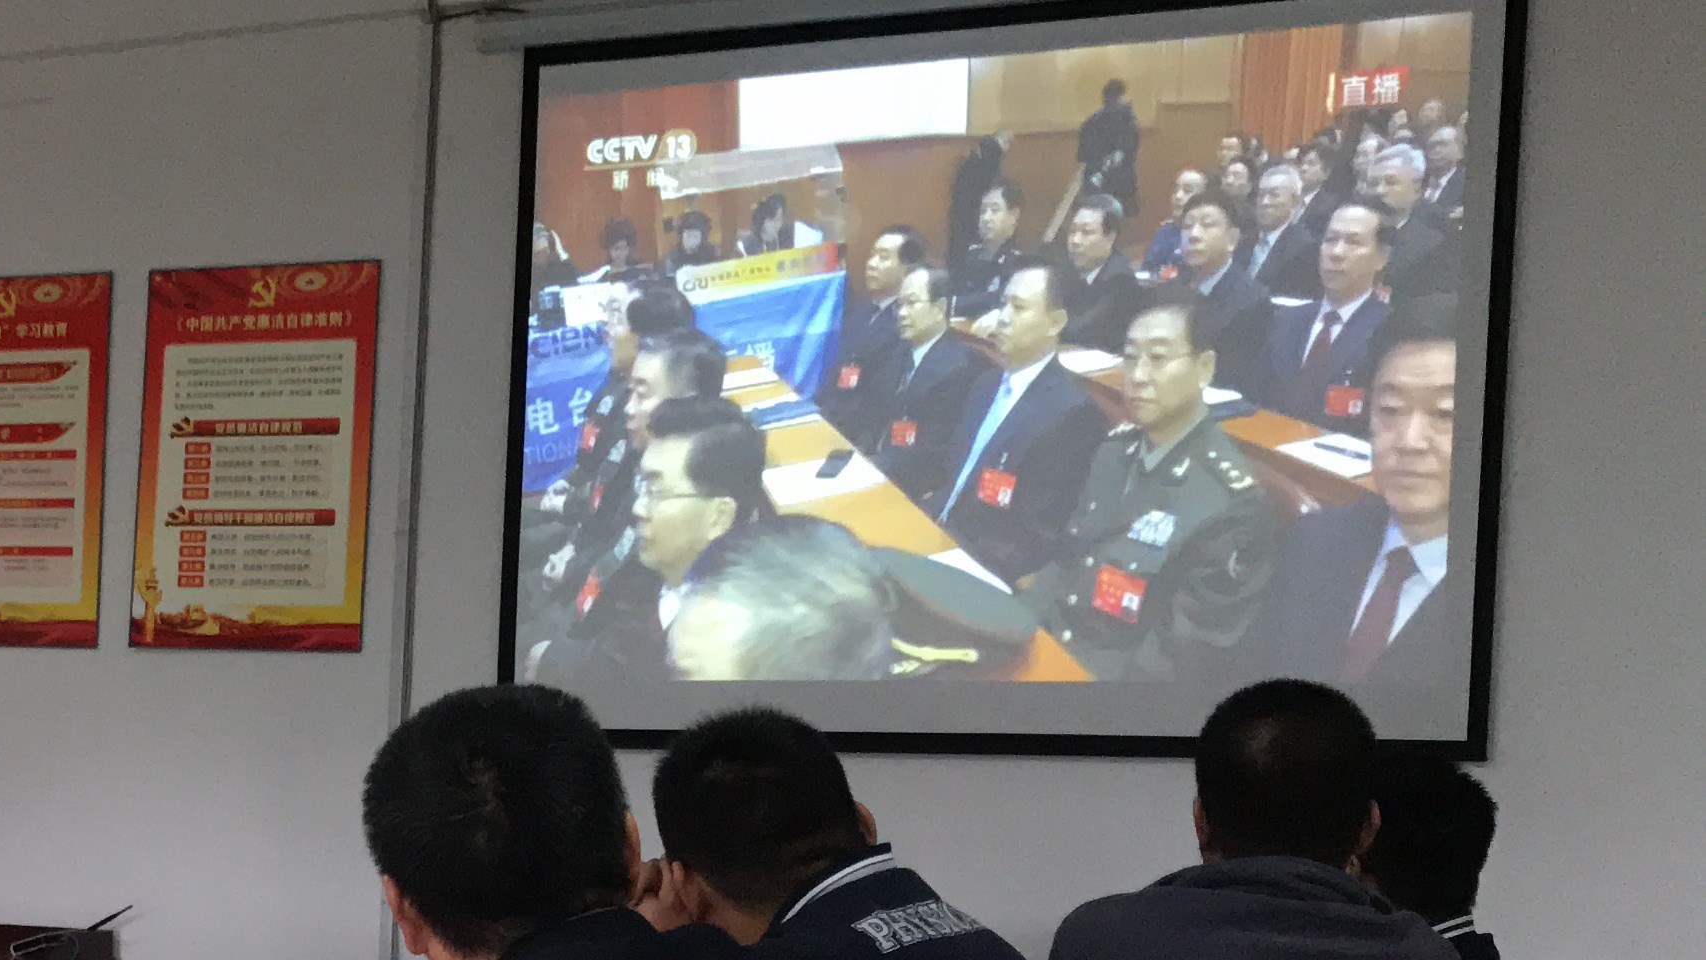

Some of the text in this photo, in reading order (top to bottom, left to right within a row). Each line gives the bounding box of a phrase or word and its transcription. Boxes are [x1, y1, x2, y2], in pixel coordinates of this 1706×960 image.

[1341, 73, 1401, 106] 直播
[586, 134, 692, 164] CCTV 13
[526, 386, 593, 436] 电台
